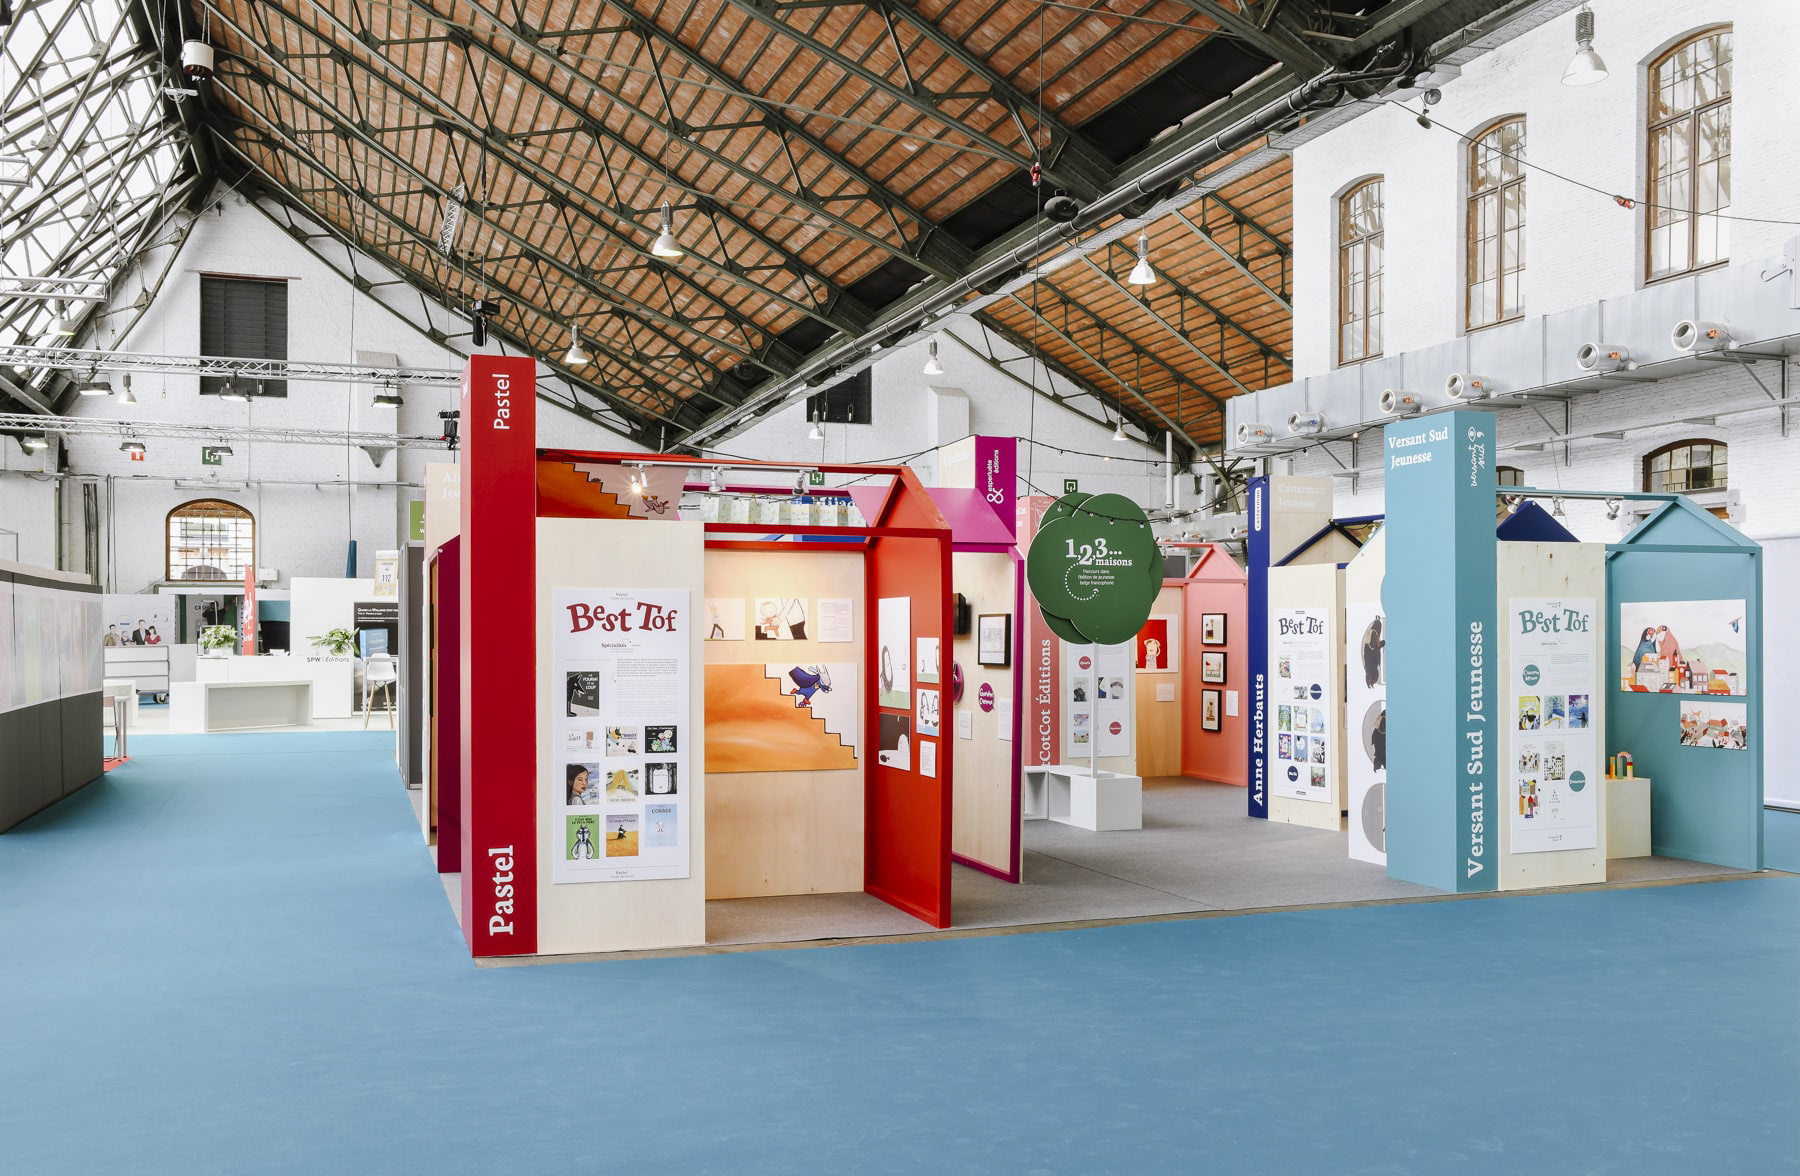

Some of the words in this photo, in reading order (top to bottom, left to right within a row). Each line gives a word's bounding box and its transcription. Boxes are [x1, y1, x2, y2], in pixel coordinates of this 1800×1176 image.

[492, 373, 510, 430] Pastel
[1388, 432, 1426, 449] Versant
[1428, 427, 1448, 442] Sud
[1390, 451, 1432, 470] Jeunesse
[381, 574, 392, 583] 112
[1095, 557, 1133, 566] maisons
[566, 603, 632, 633] Best
[636, 601, 678, 632] Tof
[1278, 617, 1304, 636] Best
[1306, 616, 1324, 635] Tof
[1518, 609, 1561, 635] Best
[1563, 608, 1589, 632] Tof
[1036, 639, 1051, 705] Éditions
[1466, 621, 1487, 722] Jeunesse
[1253, 673, 1264, 754] Herbauts
[1467, 730, 1484, 775] Sud
[1253, 758, 1264, 807] Anne
[1467, 782, 1484, 879] Versant
[488, 845, 514, 936] Pastel
